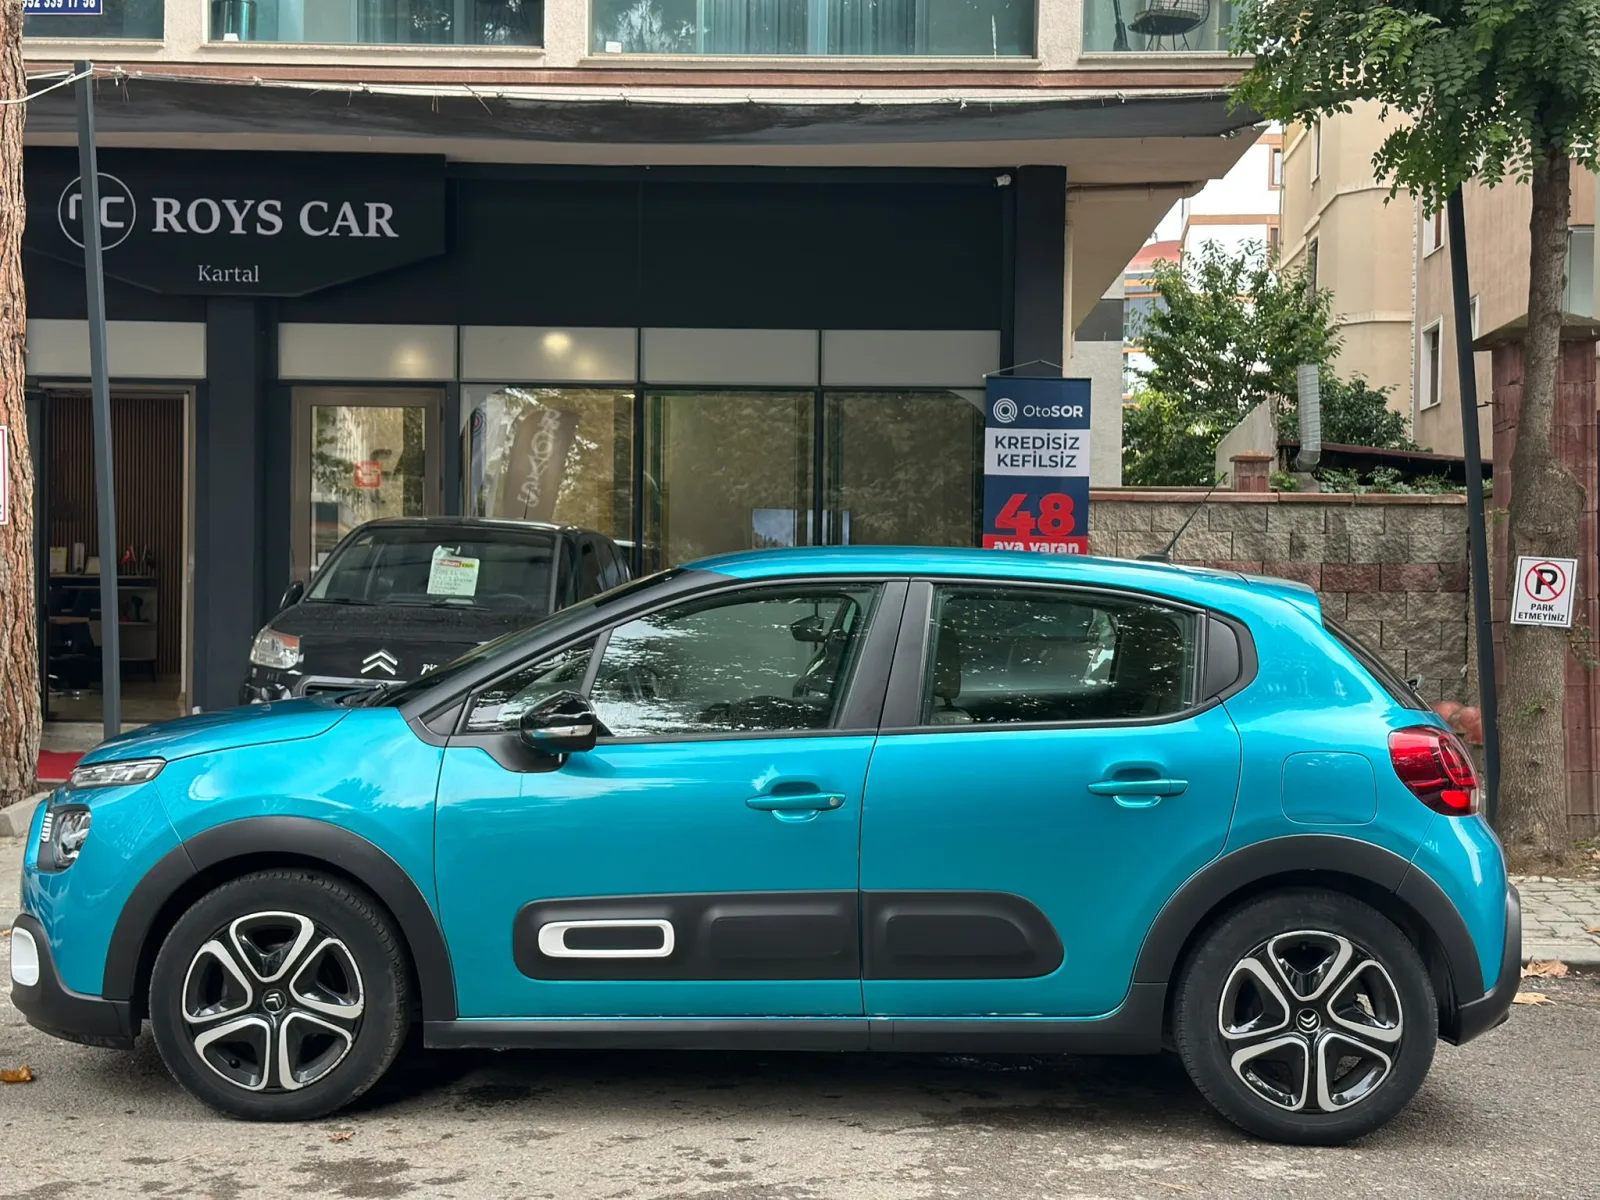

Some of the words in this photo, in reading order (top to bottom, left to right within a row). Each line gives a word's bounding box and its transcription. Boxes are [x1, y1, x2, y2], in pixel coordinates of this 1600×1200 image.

[152, 197, 283, 235] ROYS
[299, 201, 399, 238] CAR
[198, 265, 260, 283] Kartal
[1023, 404, 1084, 418] OtoSOR
[995, 433, 1080, 450] KREDİSİZ
[997, 451, 1077, 468] KEFİLSİZ
[995, 493, 1075, 537] 48
[1531, 603, 1555, 612] PARK
[1518, 612, 1565, 622] ETMEYİNİZ
